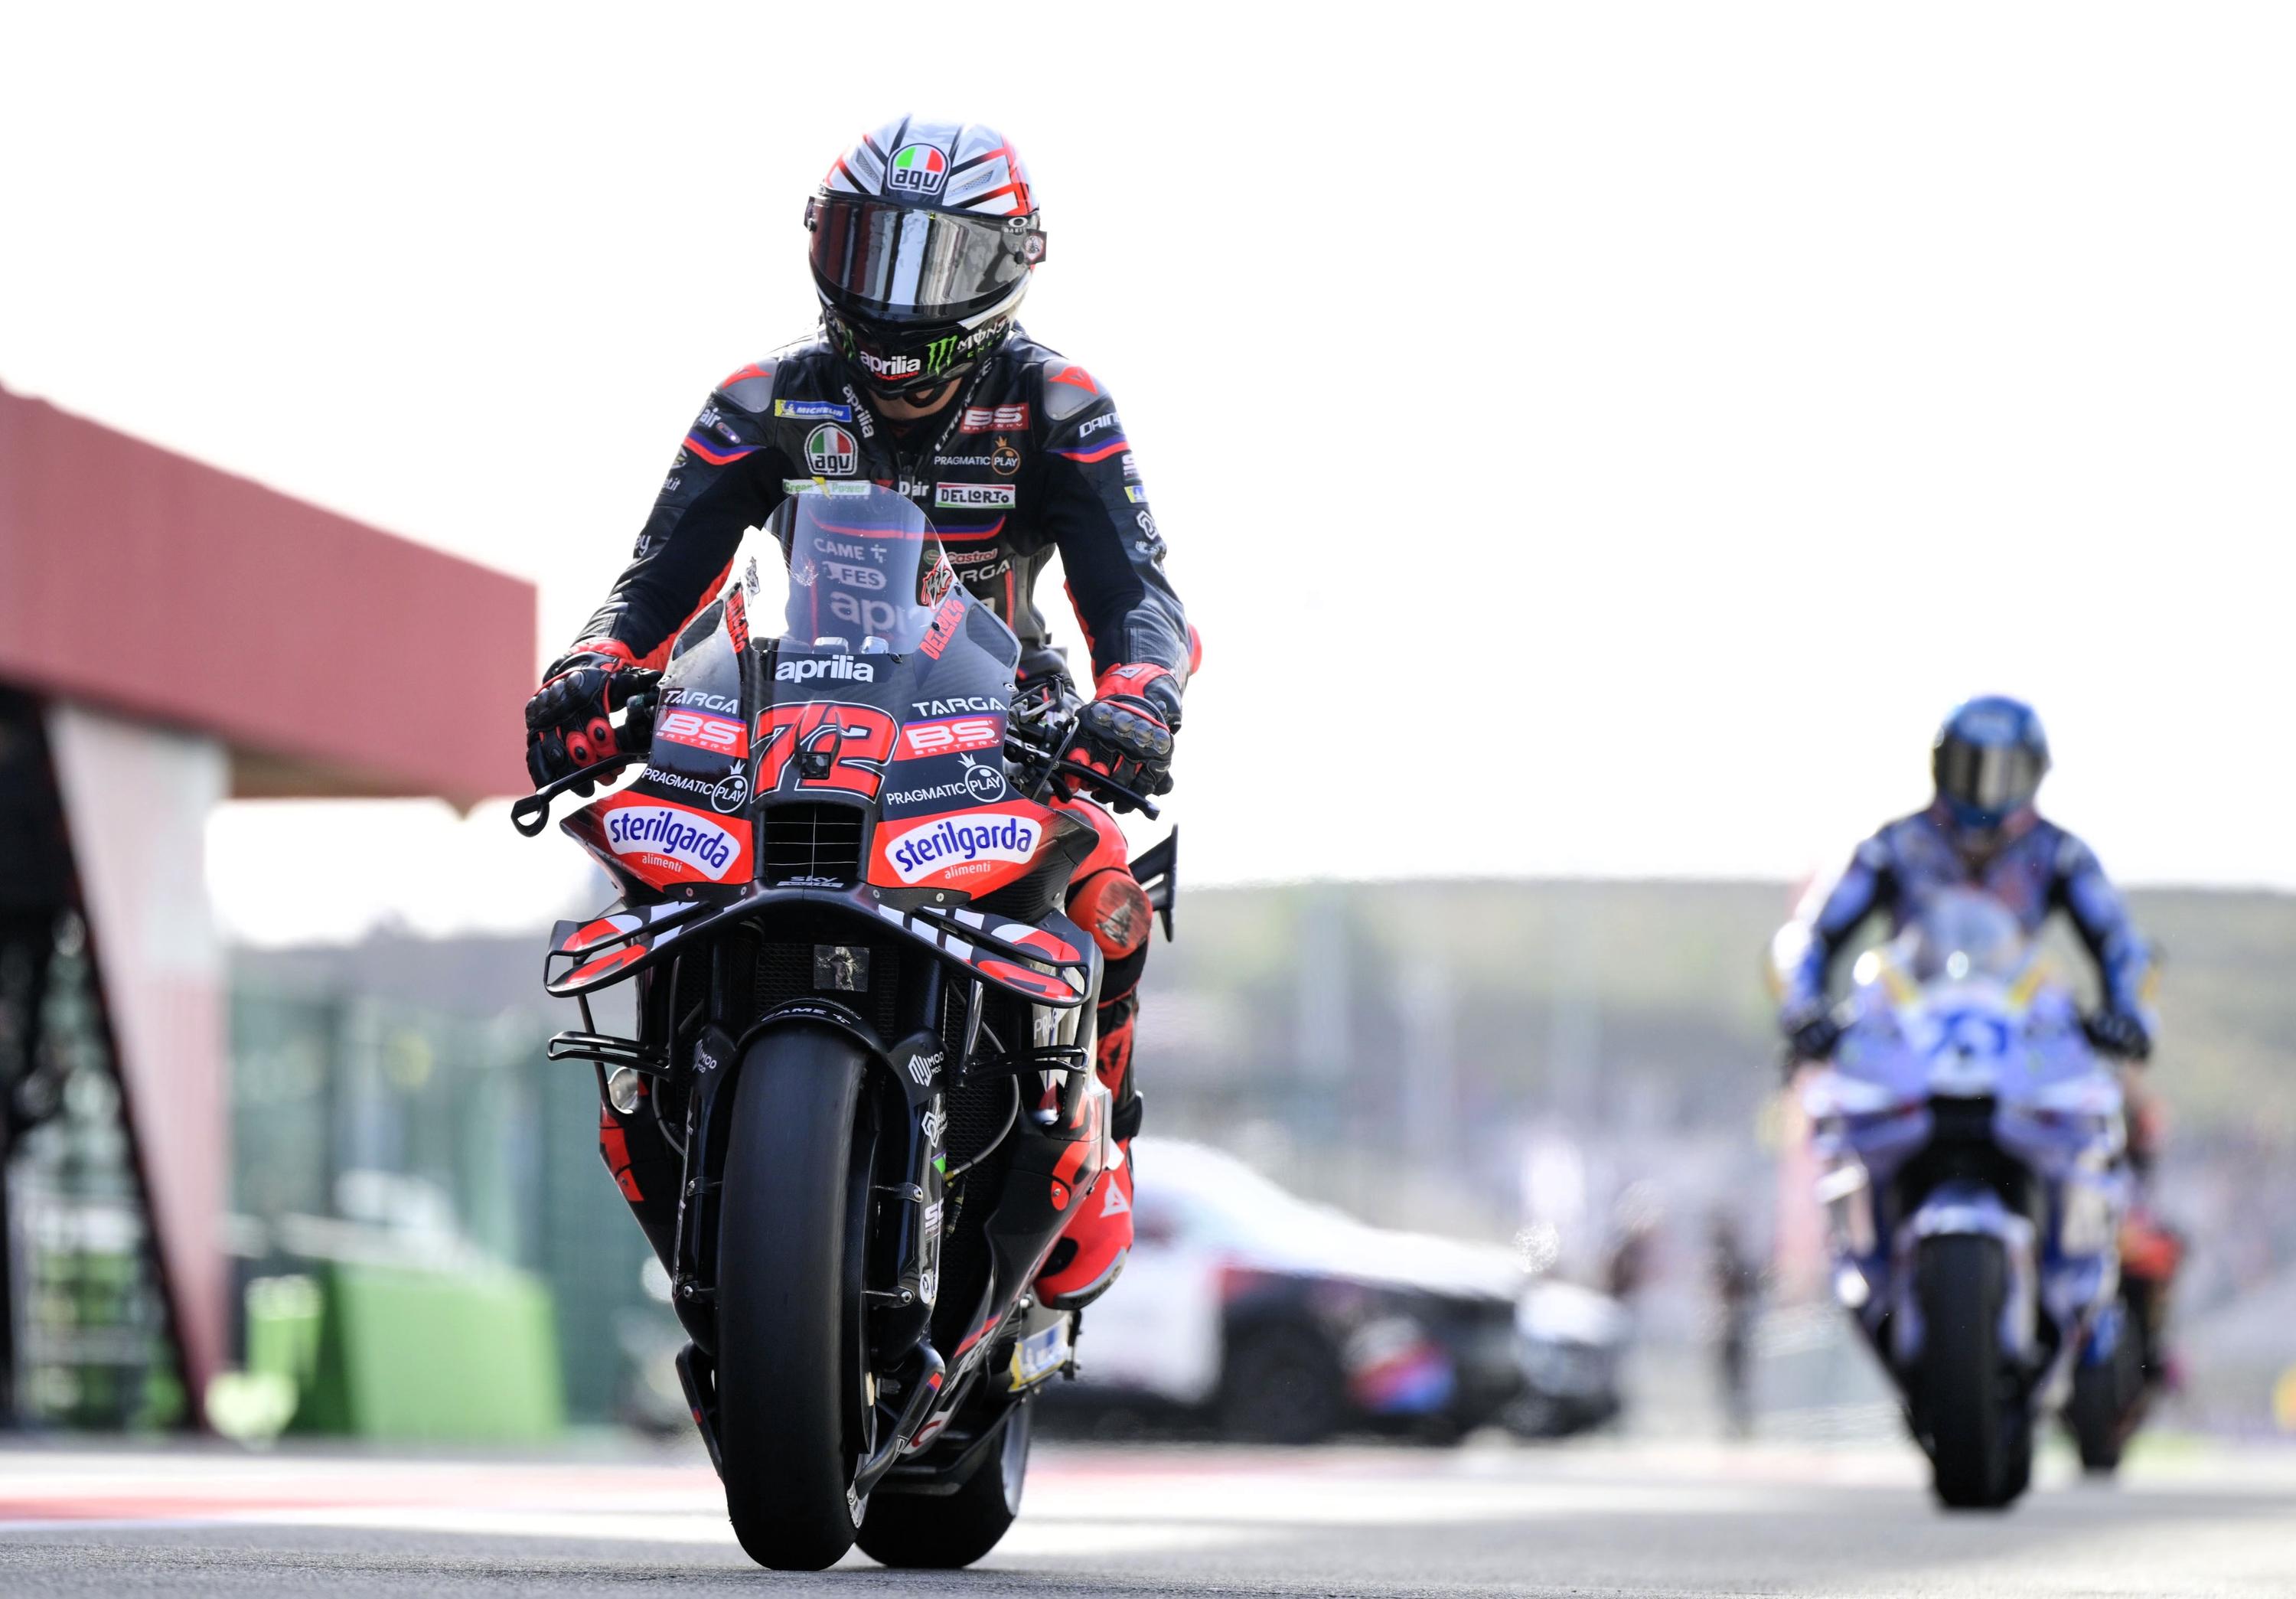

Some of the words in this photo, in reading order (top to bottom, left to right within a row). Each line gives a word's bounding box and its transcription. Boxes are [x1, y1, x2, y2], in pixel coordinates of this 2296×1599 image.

[895, 169, 938, 191] agv
[859, 351, 921, 375] aprilia
[797, 406, 844, 417] MICHELIN
[843, 383, 875, 439] aprilia
[964, 406, 1022, 426] BS
[814, 455, 850, 473] agv
[934, 455, 991, 466] PRAGMATIC
[993, 458, 1018, 468] PLAY
[941, 489, 1009, 503] DELLORTO
[814, 538, 864, 561] CAME
[946, 548, 998, 564] Castrol
[775, 654, 874, 683] aprilia
[664, 690, 739, 714] TARGA
[912, 697, 1007, 716] TARGA
[660, 713, 742, 745] BS
[906, 720, 995, 749] BS
[656, 732, 732, 751] BATTERY
[750, 700, 900, 804] 72
[915, 739, 1000, 755] BATTERY
[641, 768, 714, 795] PRAGMATIC
[715, 786, 744, 802] PLAY
[886, 782, 967, 805] PRAGMATIC
[970, 776, 1002, 792] PLAY
[610, 811, 729, 869] sterilgarda
[895, 817, 1032, 872] sterilgarda
[641, 854, 683, 873] alimenti
[944, 861, 991, 879] alimenti
[927, 1051, 944, 1067] MOD
